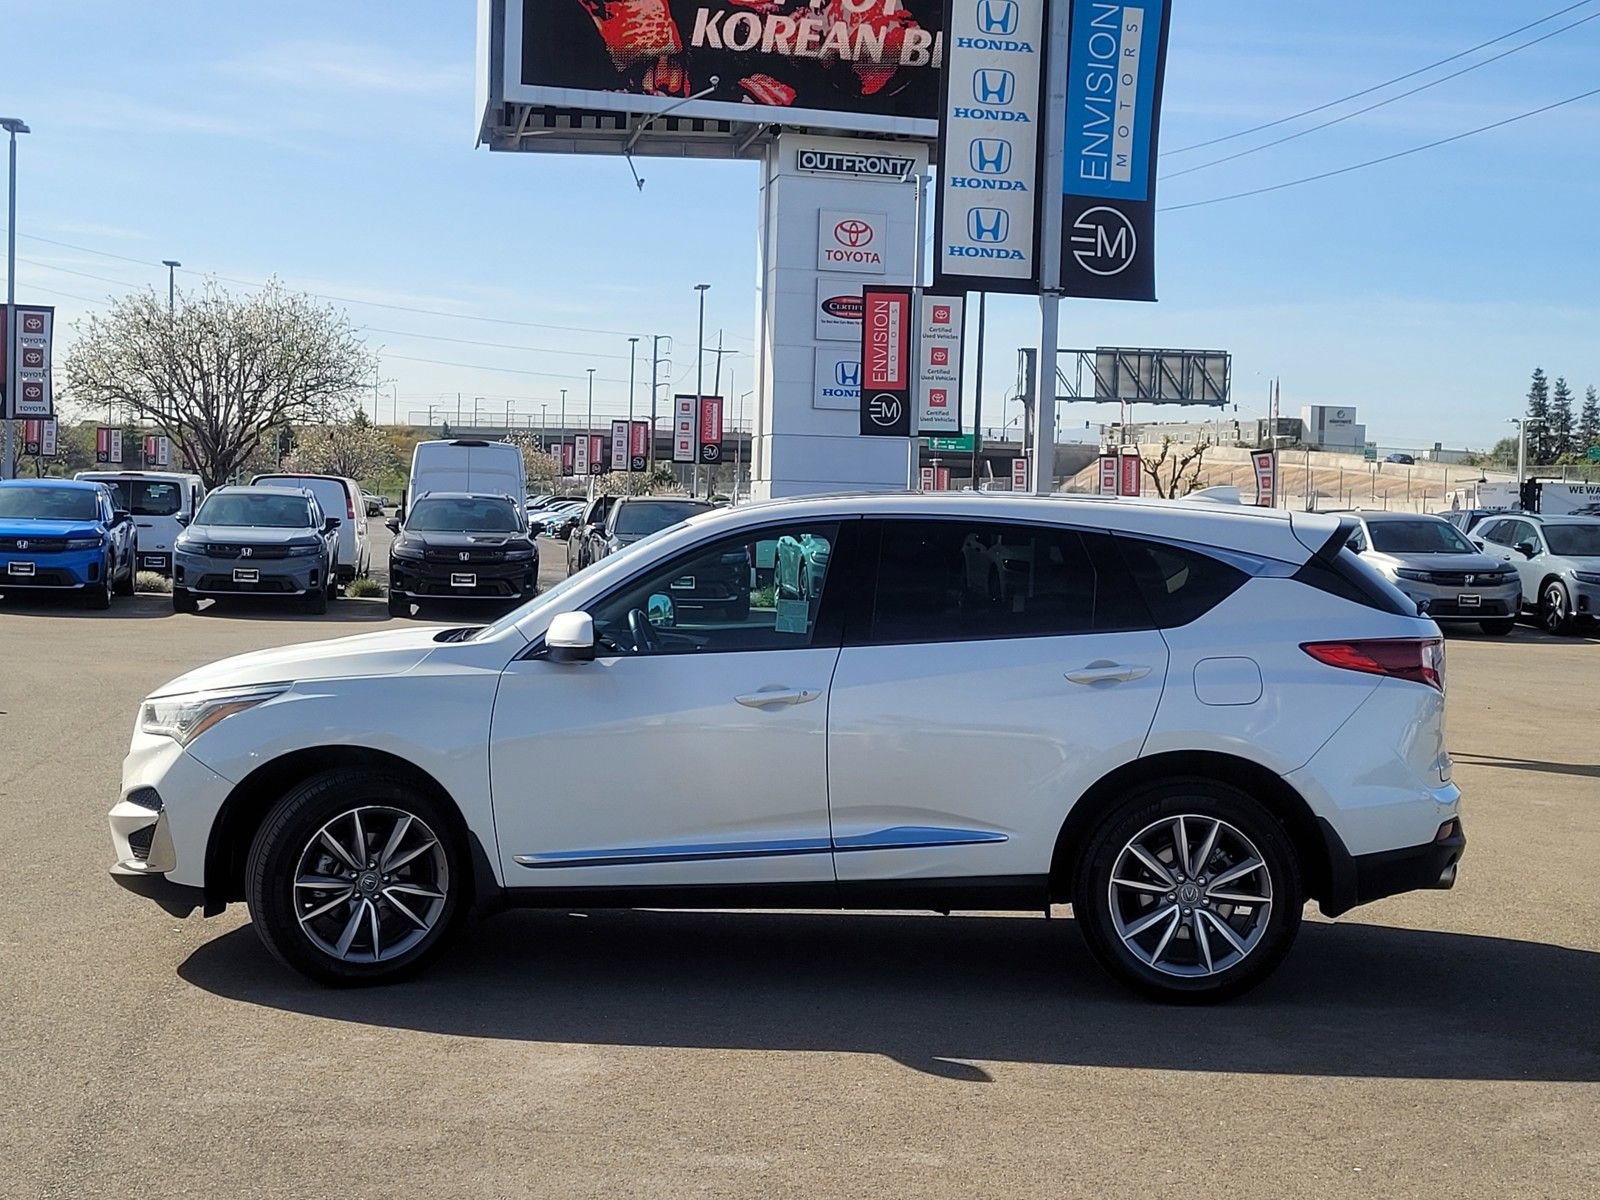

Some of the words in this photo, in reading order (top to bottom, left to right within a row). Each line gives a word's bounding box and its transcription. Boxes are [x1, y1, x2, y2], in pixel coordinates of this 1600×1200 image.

[691, 8, 887, 64] KOREAN
[957, 37, 1034, 53] HONDA
[1080, 3, 1120, 180] ENVISION
[1115, 23, 1138, 168] MOTORS
[953, 107, 1031, 122] HONDA
[951, 176, 1028, 191] HONDA
[825, 250, 881, 264] TOYOTA
[948, 245, 1026, 260] HONDA
[873, 301, 888, 382] ENVISION
[890, 308, 898, 376] MOTORS
[1569, 486, 1584, 494] WE
